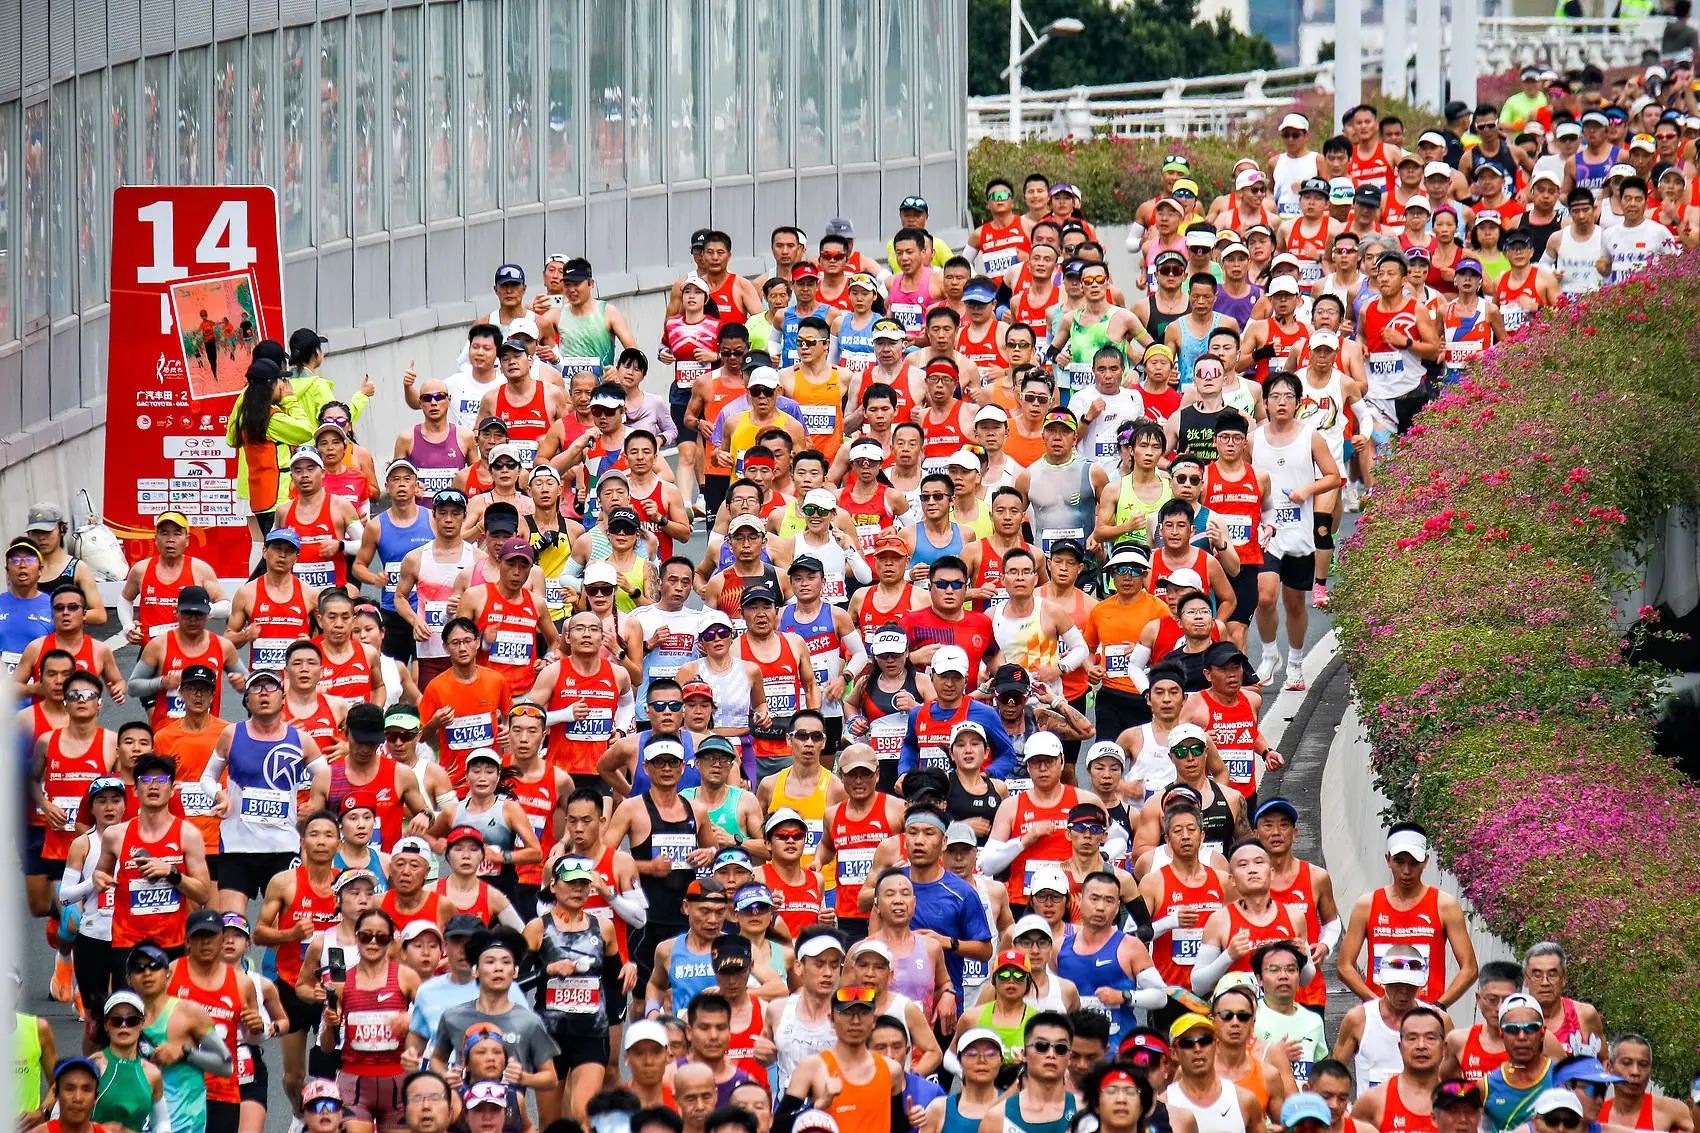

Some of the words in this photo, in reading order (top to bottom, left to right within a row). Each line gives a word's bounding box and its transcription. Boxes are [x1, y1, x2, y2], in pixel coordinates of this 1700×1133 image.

[138, 200, 257, 283] 14
[573, 719, 605, 733] A3171
[1213, 721, 1254, 729] GUANGZHOU
[453, 725, 487, 742] C1764
[249, 799, 282, 814] B1053
[138, 889, 171, 905] C2427
[555, 988, 592, 1004] B9468
[354, 1024, 392, 1042] A9945
[1291, 1062, 1306, 1076] 24
